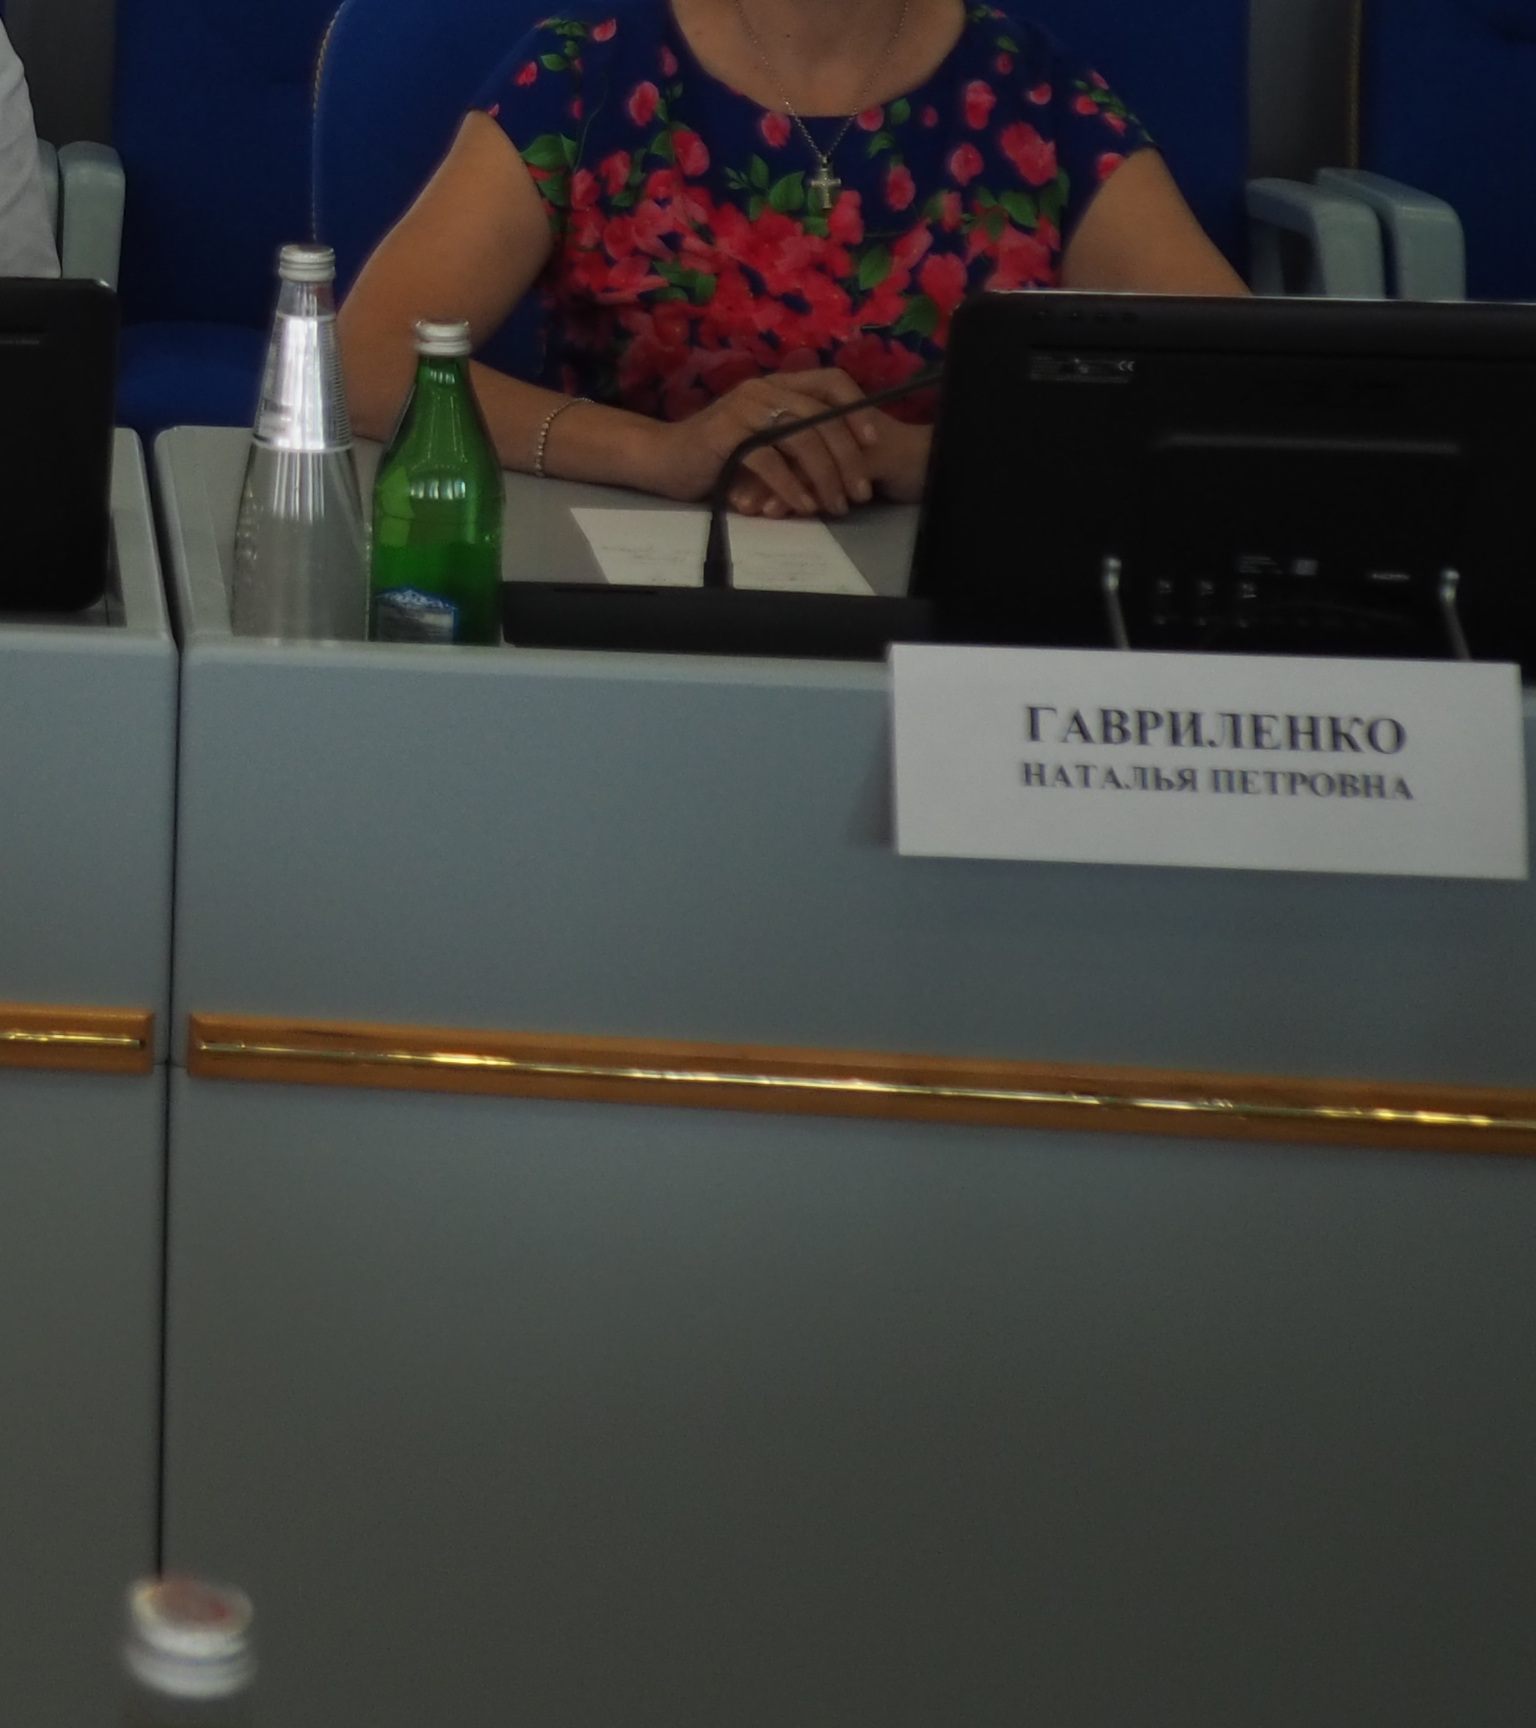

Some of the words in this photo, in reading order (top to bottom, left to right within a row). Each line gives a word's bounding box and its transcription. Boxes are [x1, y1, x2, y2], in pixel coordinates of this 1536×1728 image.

[1025, 705, 1408, 755] ГАВРИЛЕНКО
[1020, 761, 1199, 793] НАТАЛЬЯ
[1209, 768, 1415, 801] ПЕТРОВНА
